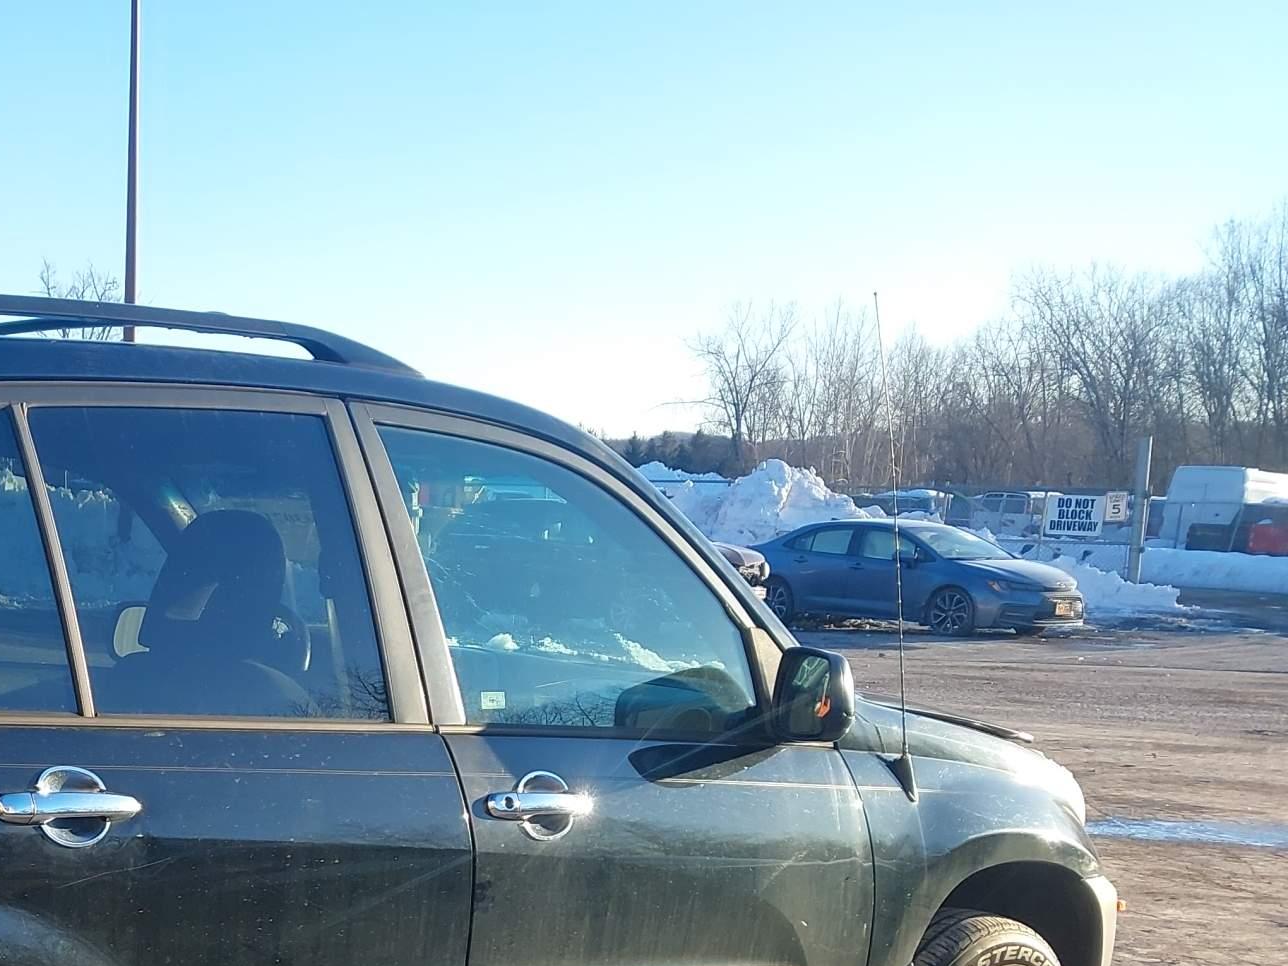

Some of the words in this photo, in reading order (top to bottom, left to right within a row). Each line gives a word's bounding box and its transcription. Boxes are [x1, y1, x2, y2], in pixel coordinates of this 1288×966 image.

[1058, 498, 1072, 509] DO
[1074, 498, 1096, 509] NOT
[1111, 504, 1121, 514] 5
[1058, 509, 1093, 520] BLOCK
[1050, 520, 1098, 532] DRIVEWAY
